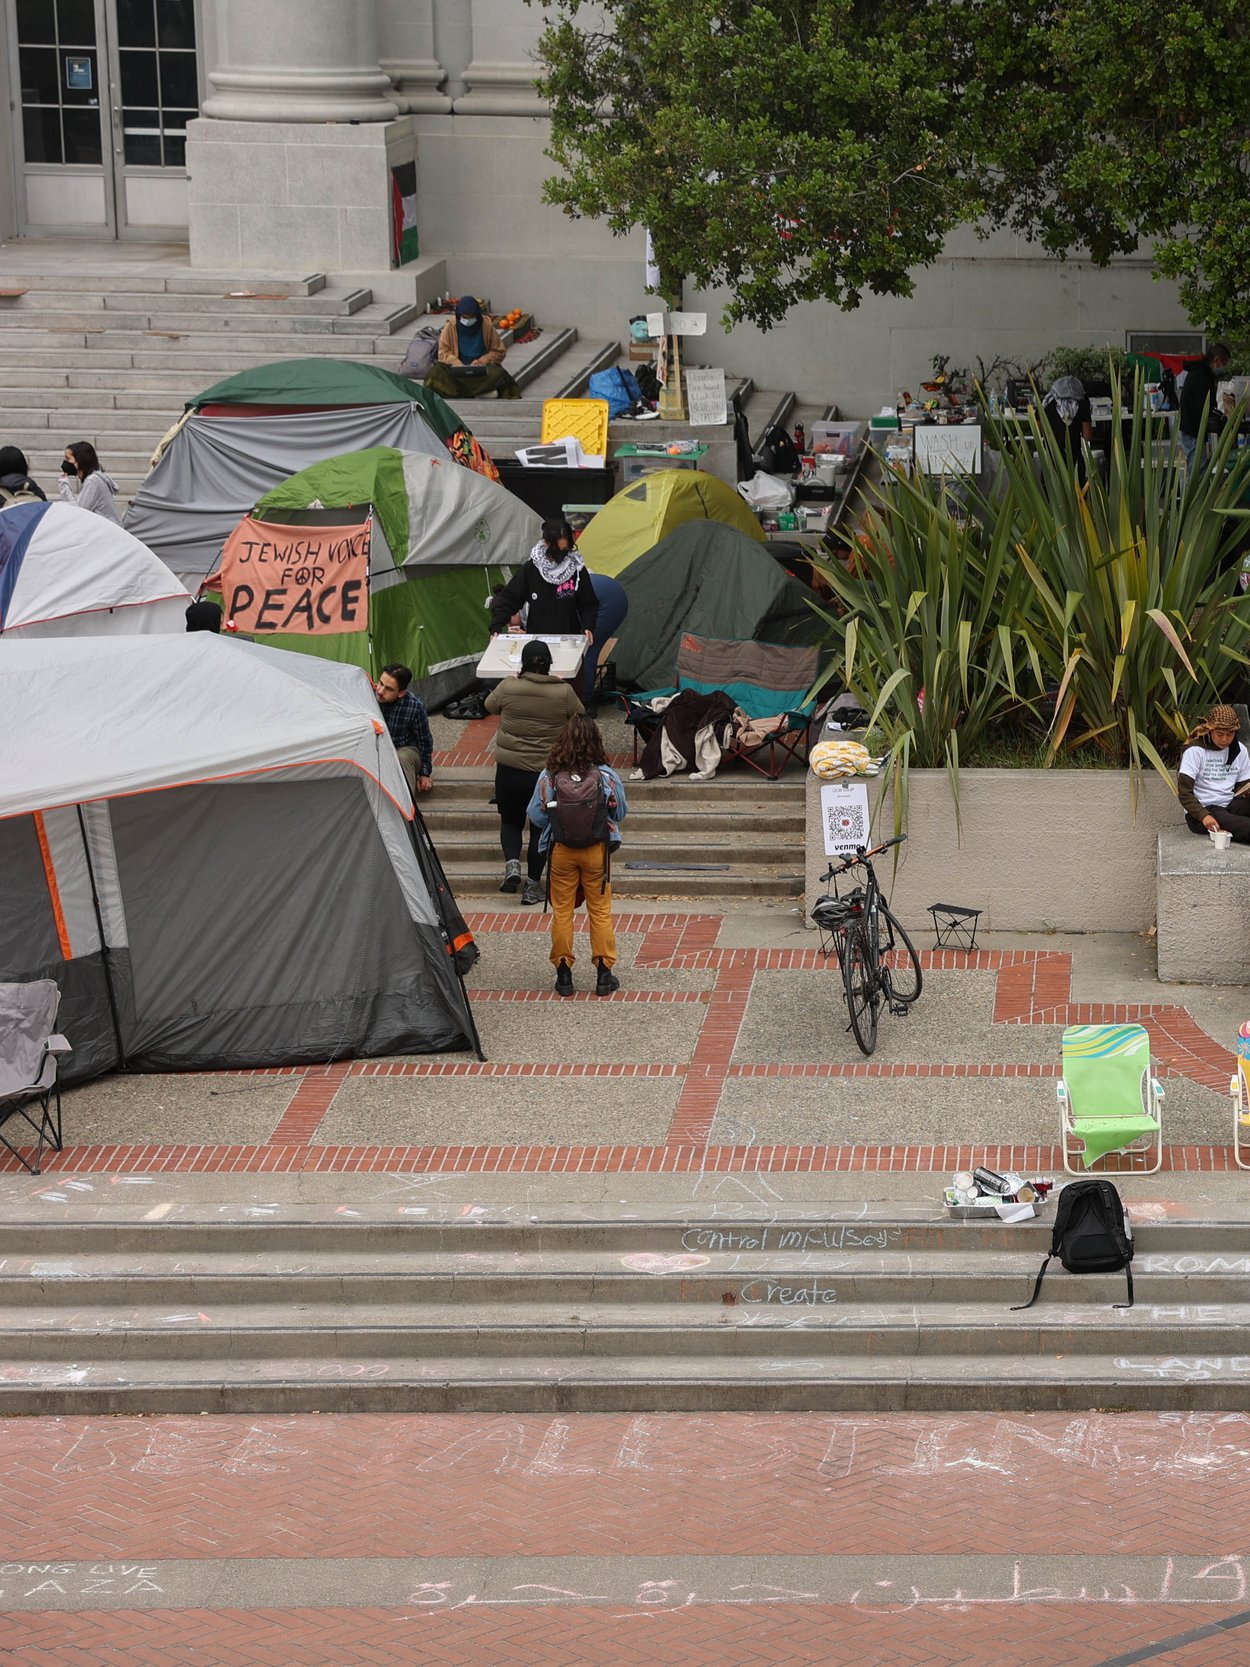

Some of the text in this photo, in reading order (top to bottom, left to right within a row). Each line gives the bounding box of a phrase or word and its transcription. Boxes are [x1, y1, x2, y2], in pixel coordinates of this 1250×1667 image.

[920, 433, 958, 451] WASH
[239, 531, 370, 564] JEWISH VOICE
[281, 566, 325, 586] FOR
[229, 580, 362, 630] PEACE
[1141, 1256, 1250, 1274] ROM
[741, 1279, 837, 1306] Create
[1113, 1305, 1226, 1321] THE
[0, 1563, 157, 1578] ONG LIVE
[0, 1579, 165, 1597] AZA
